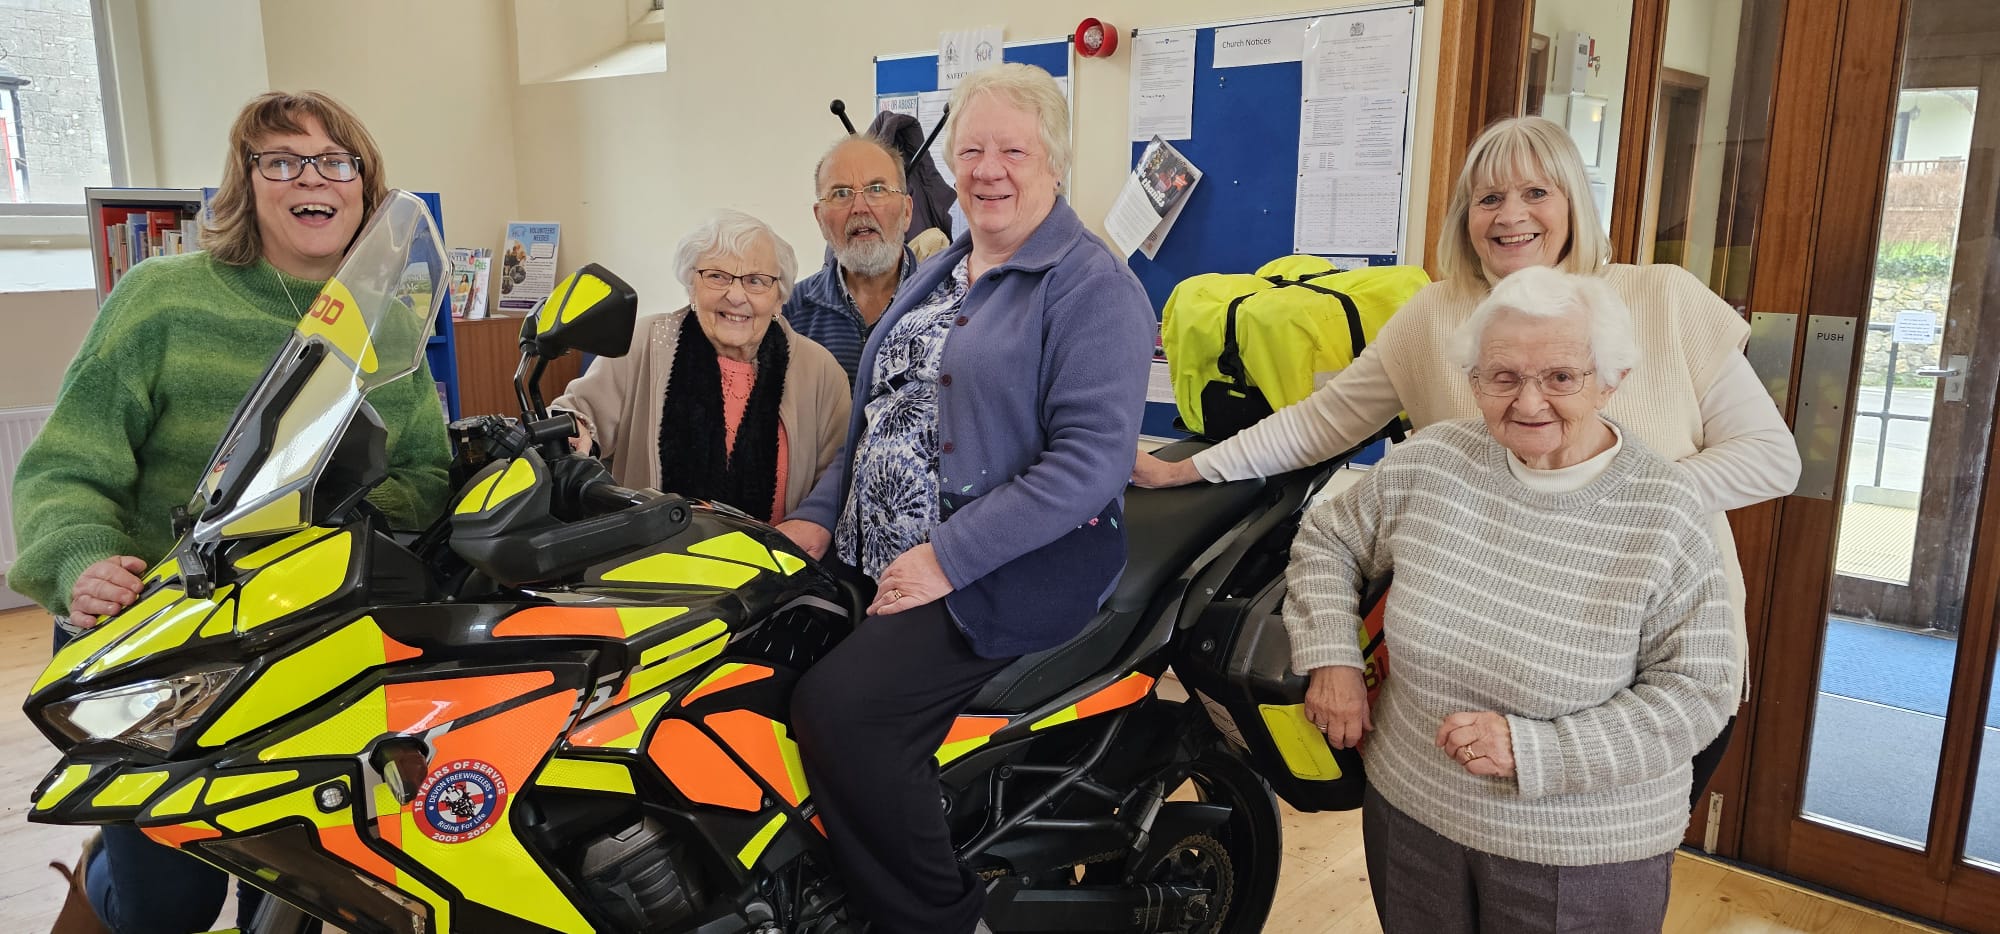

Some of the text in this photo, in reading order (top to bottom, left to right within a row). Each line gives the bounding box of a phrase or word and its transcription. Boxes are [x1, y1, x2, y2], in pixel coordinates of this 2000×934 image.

[1222, 37, 1271, 48] Church Notices
[1141, 178, 1166, 208] thanks
[1817, 332, 1844, 341] PUSH
[415, 761, 506, 812] 15 YEARS OF SERVICE
[429, 772, 492, 803] DEVON FREEWHEELERS
[432, 832, 458, 842] 2009
[467, 822, 491, 839] 2024
[437, 813, 487, 832] Riding For Life
